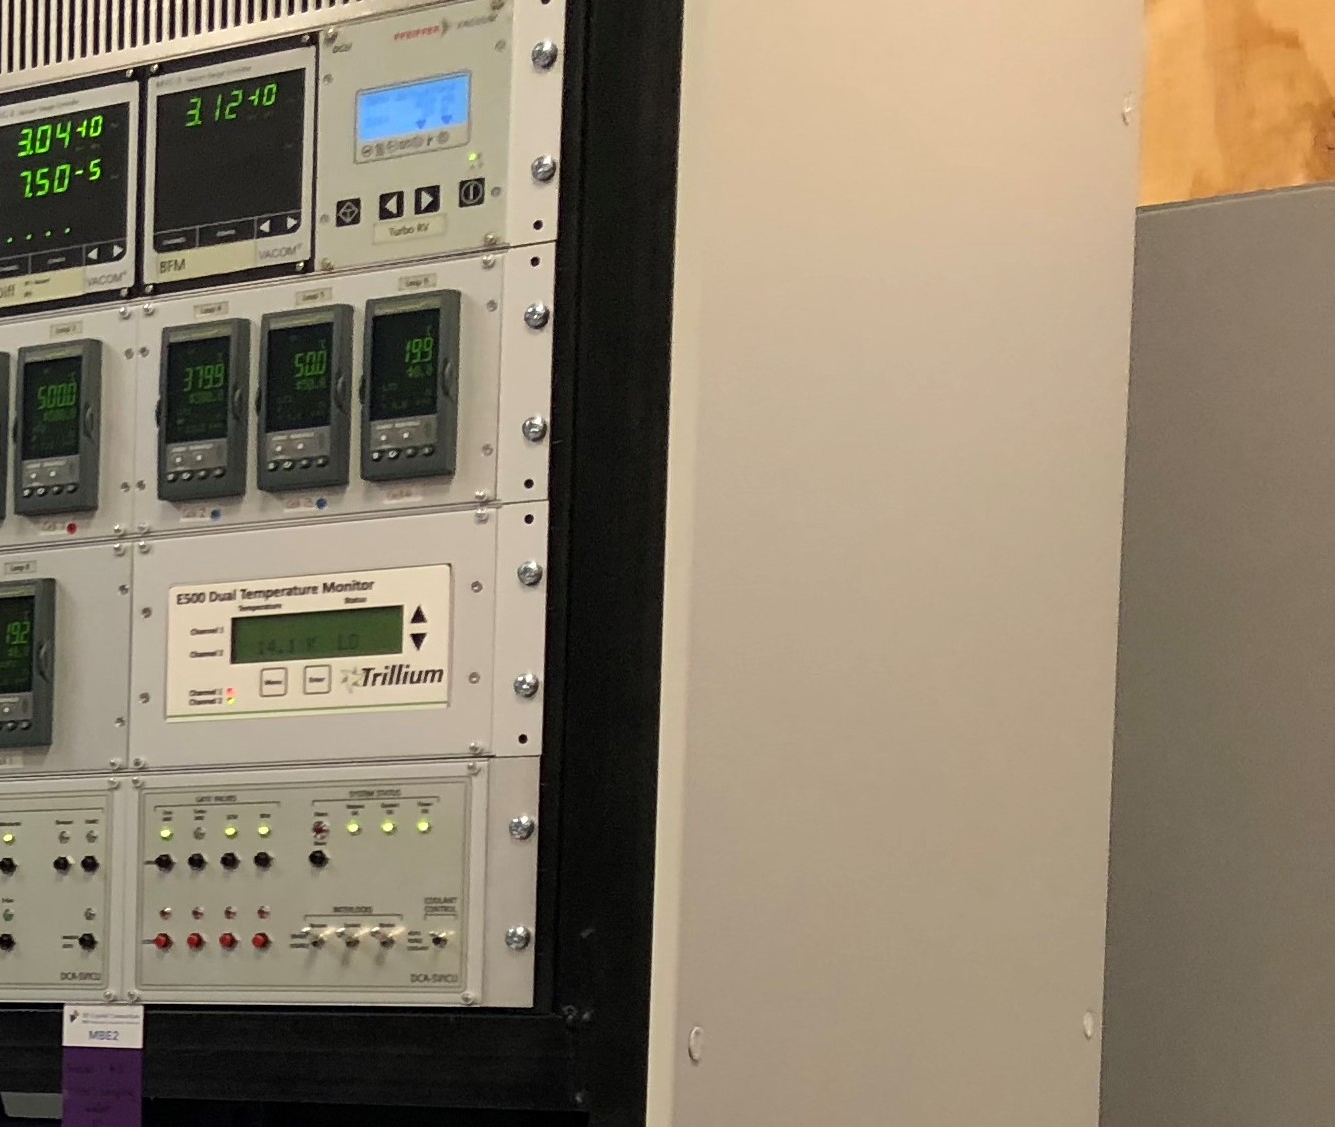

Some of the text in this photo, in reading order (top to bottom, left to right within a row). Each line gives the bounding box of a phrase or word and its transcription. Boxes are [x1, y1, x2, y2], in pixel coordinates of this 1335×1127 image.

[388, 223, 415, 236] Turbo
[159, 258, 186, 274] BFM
[176, 579, 375, 605] E500 Dual Temperature Monitor
[360, 663, 445, 688] Trillium
[88, 1030, 120, 1041] MBE2
